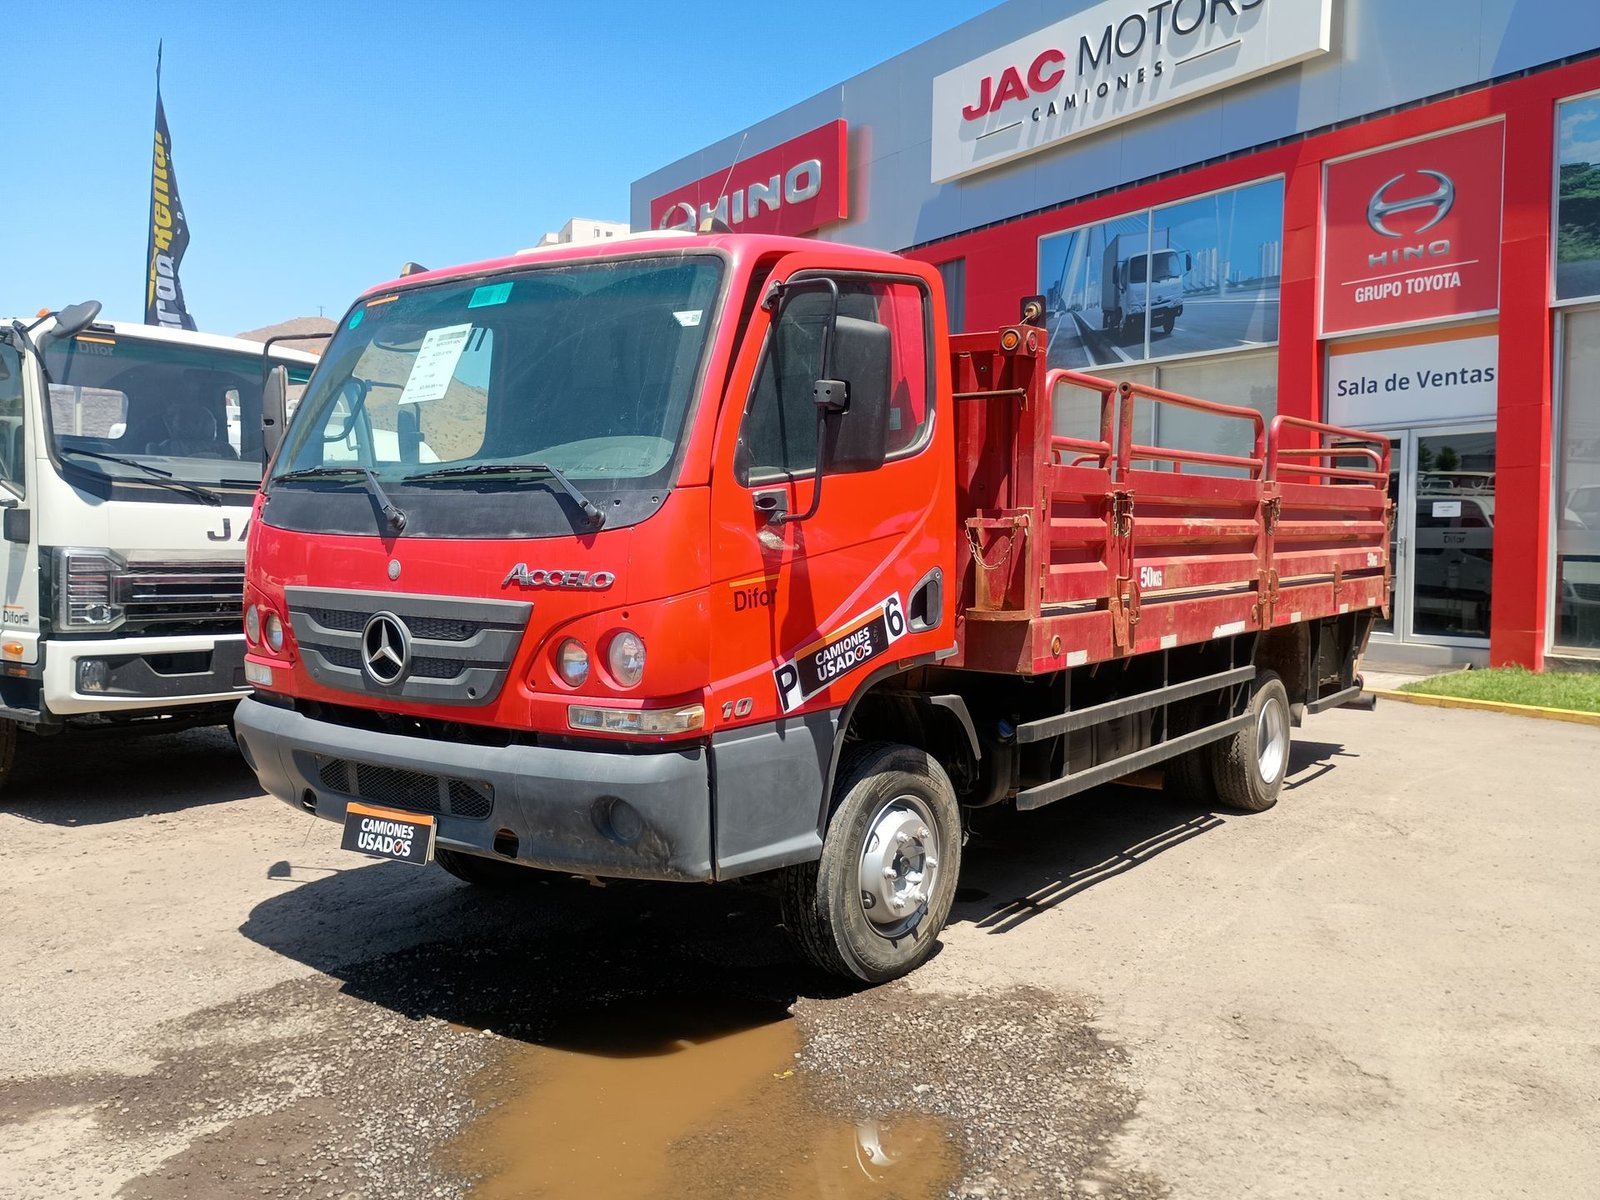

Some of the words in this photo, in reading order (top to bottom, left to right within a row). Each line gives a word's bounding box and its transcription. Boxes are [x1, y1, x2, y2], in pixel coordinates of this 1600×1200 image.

[961, 48, 1067, 122] JAC
[1077, 0, 1262, 76] MOTOR
[1031, 60, 1164, 123] CAMIONES
[699, 158, 823, 230] HINO
[1368, 239, 1451, 268] HINO
[1355, 281, 1402, 303] GRUPO
[1405, 271, 1461, 295] TOYOTA
[1337, 376, 1378, 397] Sala
[1384, 373, 1411, 392] de
[1416, 366, 1495, 389] Ventas
[734, 588, 778, 612] Difor
[885, 597, 904, 638] 6
[815, 627, 870, 666] CAMIONES
[816, 640, 873, 682] USADOS
[774, 663, 798, 712] P
[721, 697, 753, 719] 10
[357, 832, 412, 857] USADOS
[361, 818, 415, 839] CAMIONES
